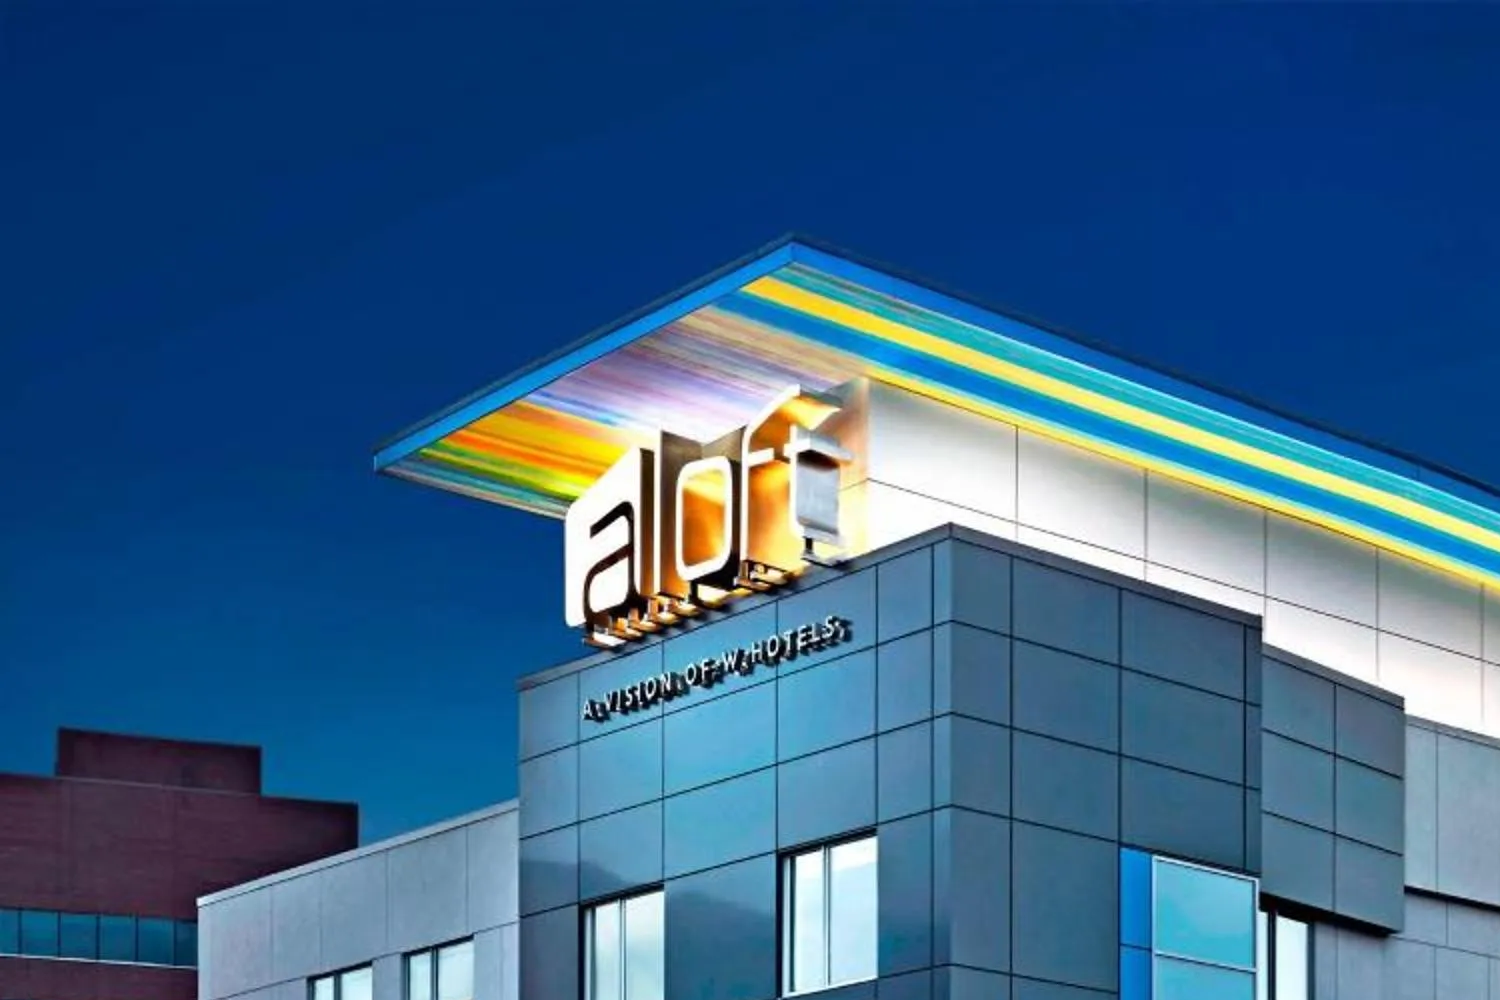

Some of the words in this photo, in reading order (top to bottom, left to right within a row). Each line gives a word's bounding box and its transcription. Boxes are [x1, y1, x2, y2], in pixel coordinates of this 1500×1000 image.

[564, 384, 850, 628] aloft
[604, 671, 674, 714] VISION
[686, 658, 714, 687] OF
[721, 647, 741, 673] W
[751, 615, 838, 663] HOTELS
